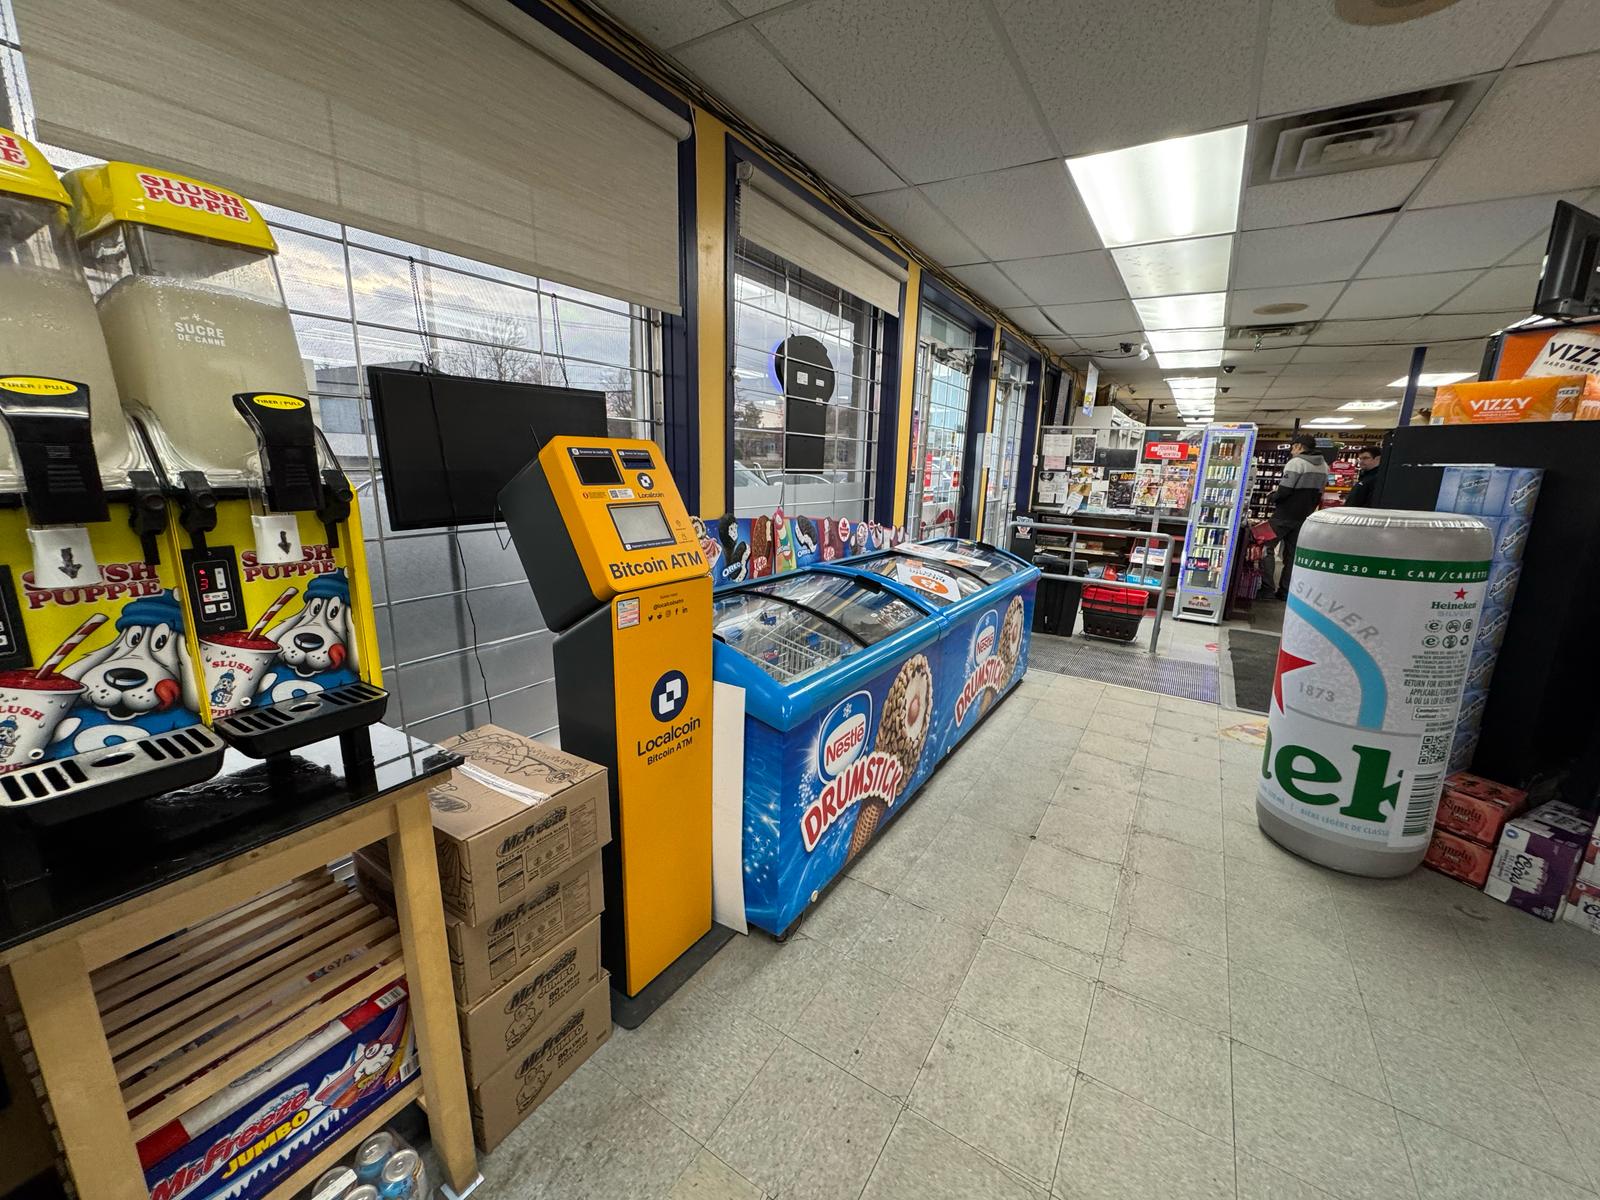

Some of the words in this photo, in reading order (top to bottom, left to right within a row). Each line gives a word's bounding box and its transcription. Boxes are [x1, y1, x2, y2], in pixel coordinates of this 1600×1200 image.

[138, 174, 242, 209] SLUSH
[174, 321, 225, 340] SUCRE
[177, 333, 191, 342] DE
[194, 335, 226, 347] CANNE
[1549, 342, 1600, 367] VIZZ
[1544, 360, 1566, 368] HARD
[1569, 364, 1600, 375] SELTZE
[1470, 397, 1533, 411] VIZZY
[608, 557, 668, 580] Bitcoin
[671, 551, 703, 569] ATM
[722, 562, 742, 577] OREO
[1343, 564, 1369, 574] 330
[1296, 581, 1380, 640] SILVER
[1430, 601, 1477, 610] Heineken
[212, 660, 253, 674] SLUSH
[956, 658, 1004, 724] DRUMSTICK
[1300, 681, 1335, 702] 1873
[0, 703, 45, 720] LUSH
[637, 716, 701, 756] Localcoin
[825, 722, 865, 767] Nestlé
[647, 747, 675, 766] Bitcoin
[676, 737, 693, 759] ATM
[804, 755, 901, 847] DRUMSTICK
[221, 1108, 311, 1180] JUMBO
